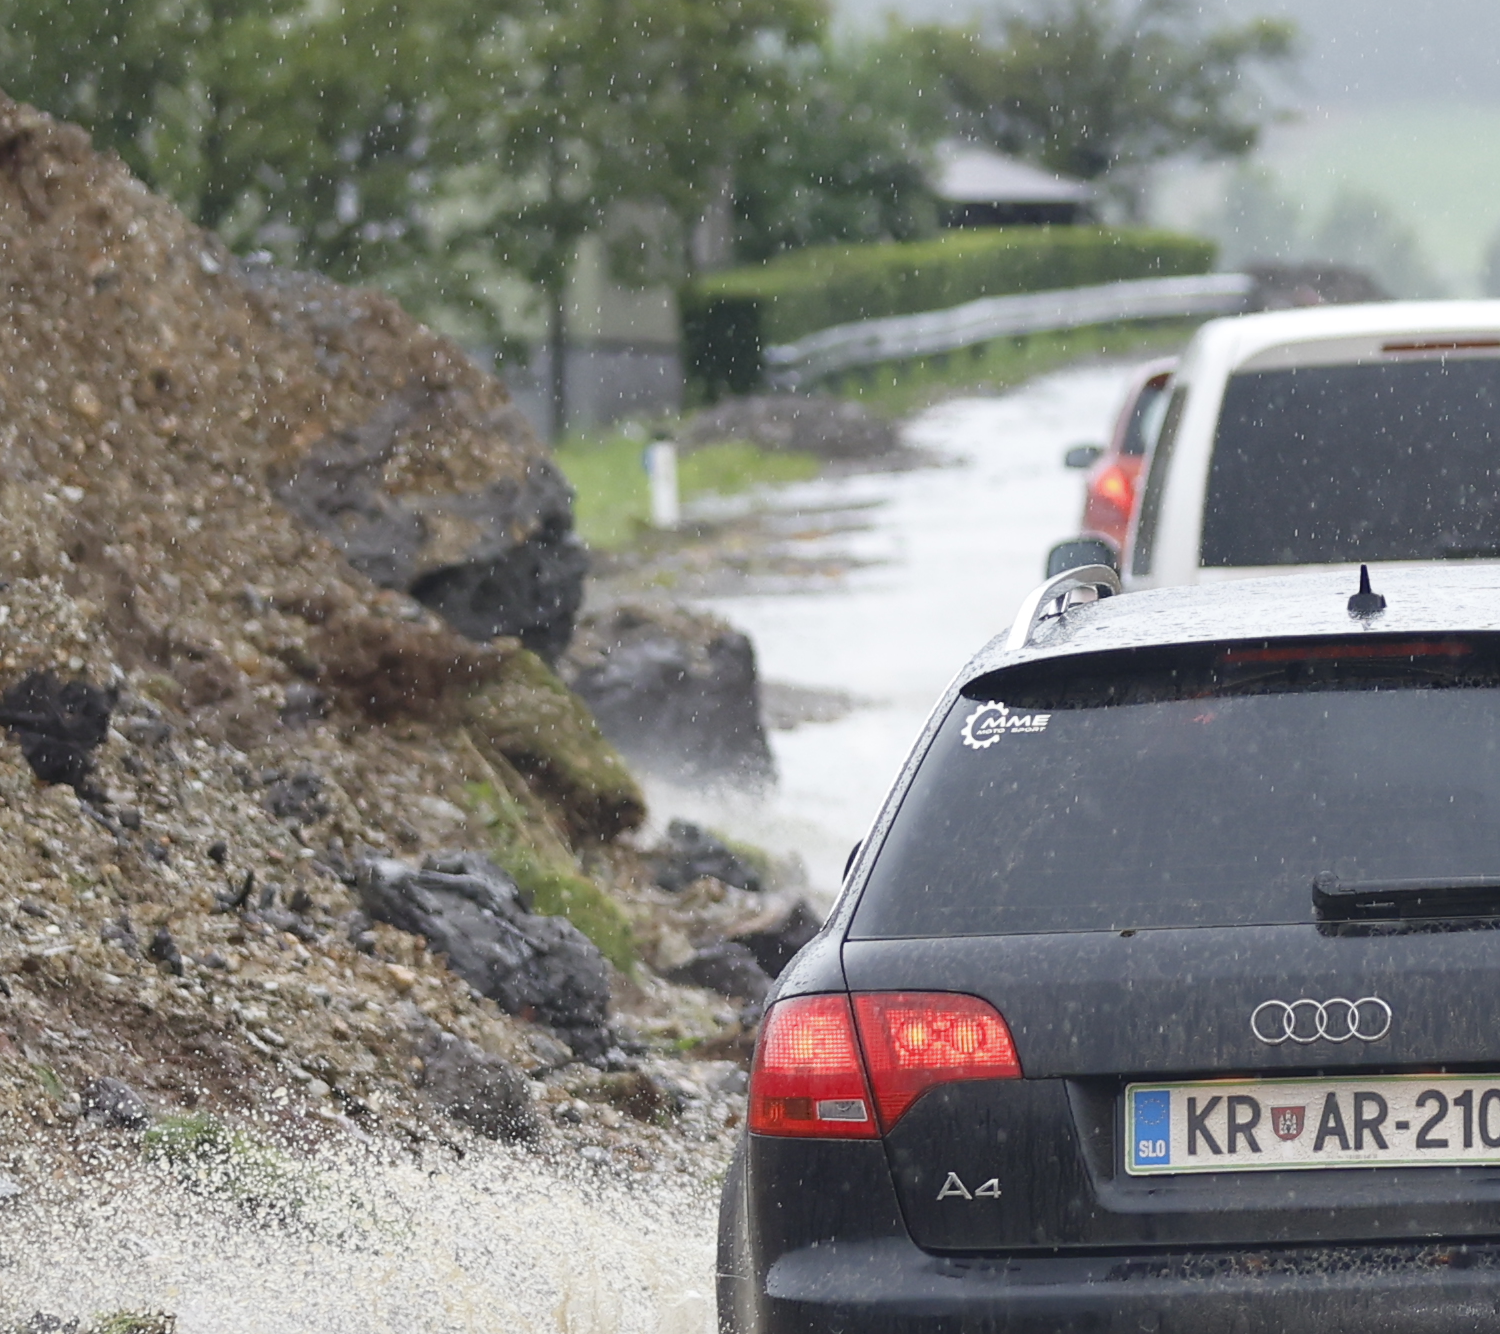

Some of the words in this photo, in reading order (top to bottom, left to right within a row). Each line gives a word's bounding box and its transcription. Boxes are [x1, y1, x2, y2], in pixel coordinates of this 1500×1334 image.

[980, 714, 1052, 729] MME
[1187, 1095, 1263, 1156] KR
[1139, 1139, 1166, 1158] SLO
[936, 1172, 1002, 1200] A4
